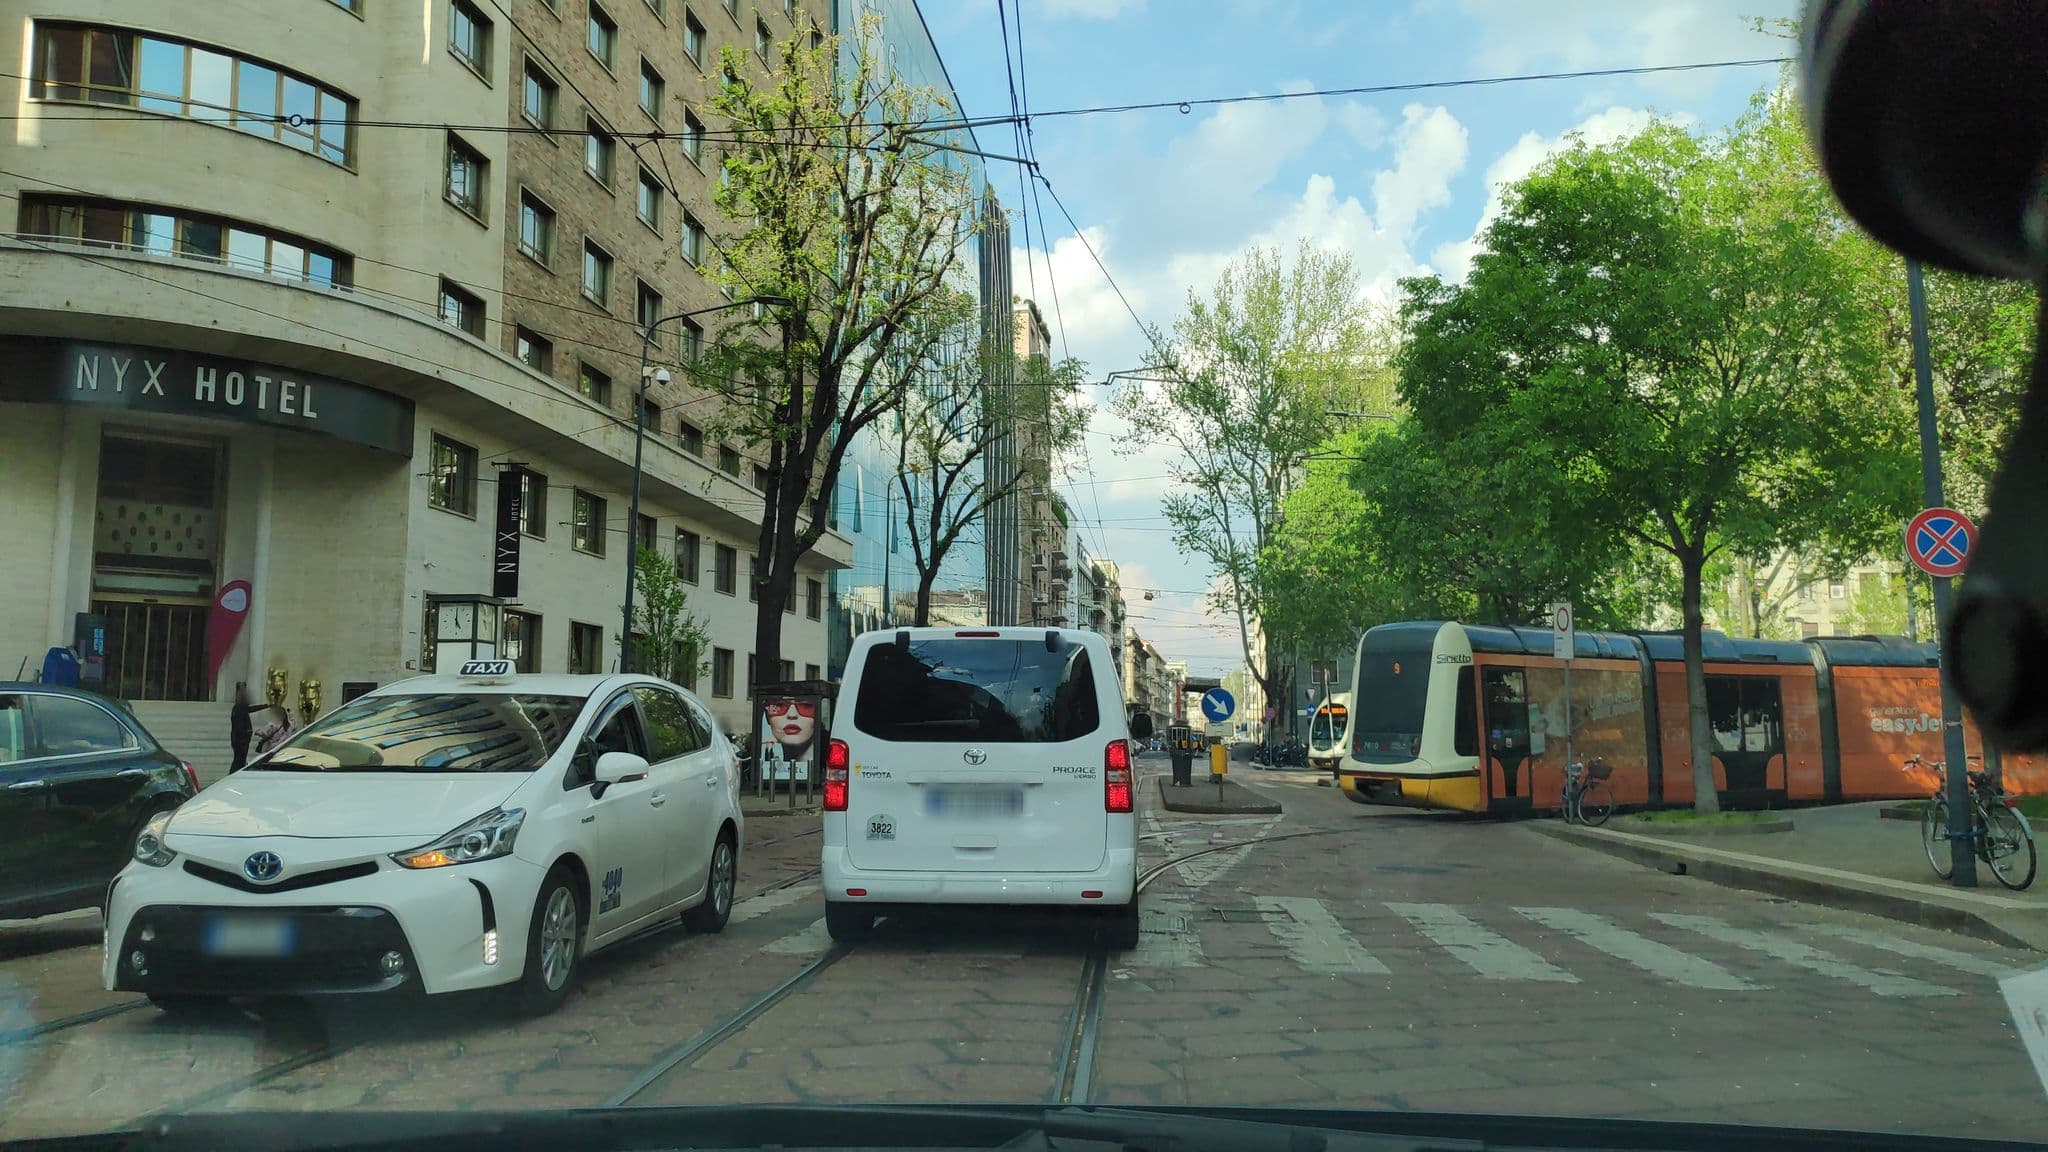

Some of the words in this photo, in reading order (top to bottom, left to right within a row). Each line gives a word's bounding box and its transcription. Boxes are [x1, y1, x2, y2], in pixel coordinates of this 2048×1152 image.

[76, 354, 167, 396] NYX
[195, 366, 318, 419] HOTEL
[497, 531, 518, 573] NYX
[511, 498, 520, 521] HOTEL
[465, 662, 506, 674] TAXI
[1393, 662, 1400, 674] 9
[1871, 712, 1943, 736] easyJe
[861, 771, 892, 779] TOYOTA
[1052, 766, 1097, 774] PROACE
[871, 822, 892, 834] 3822
